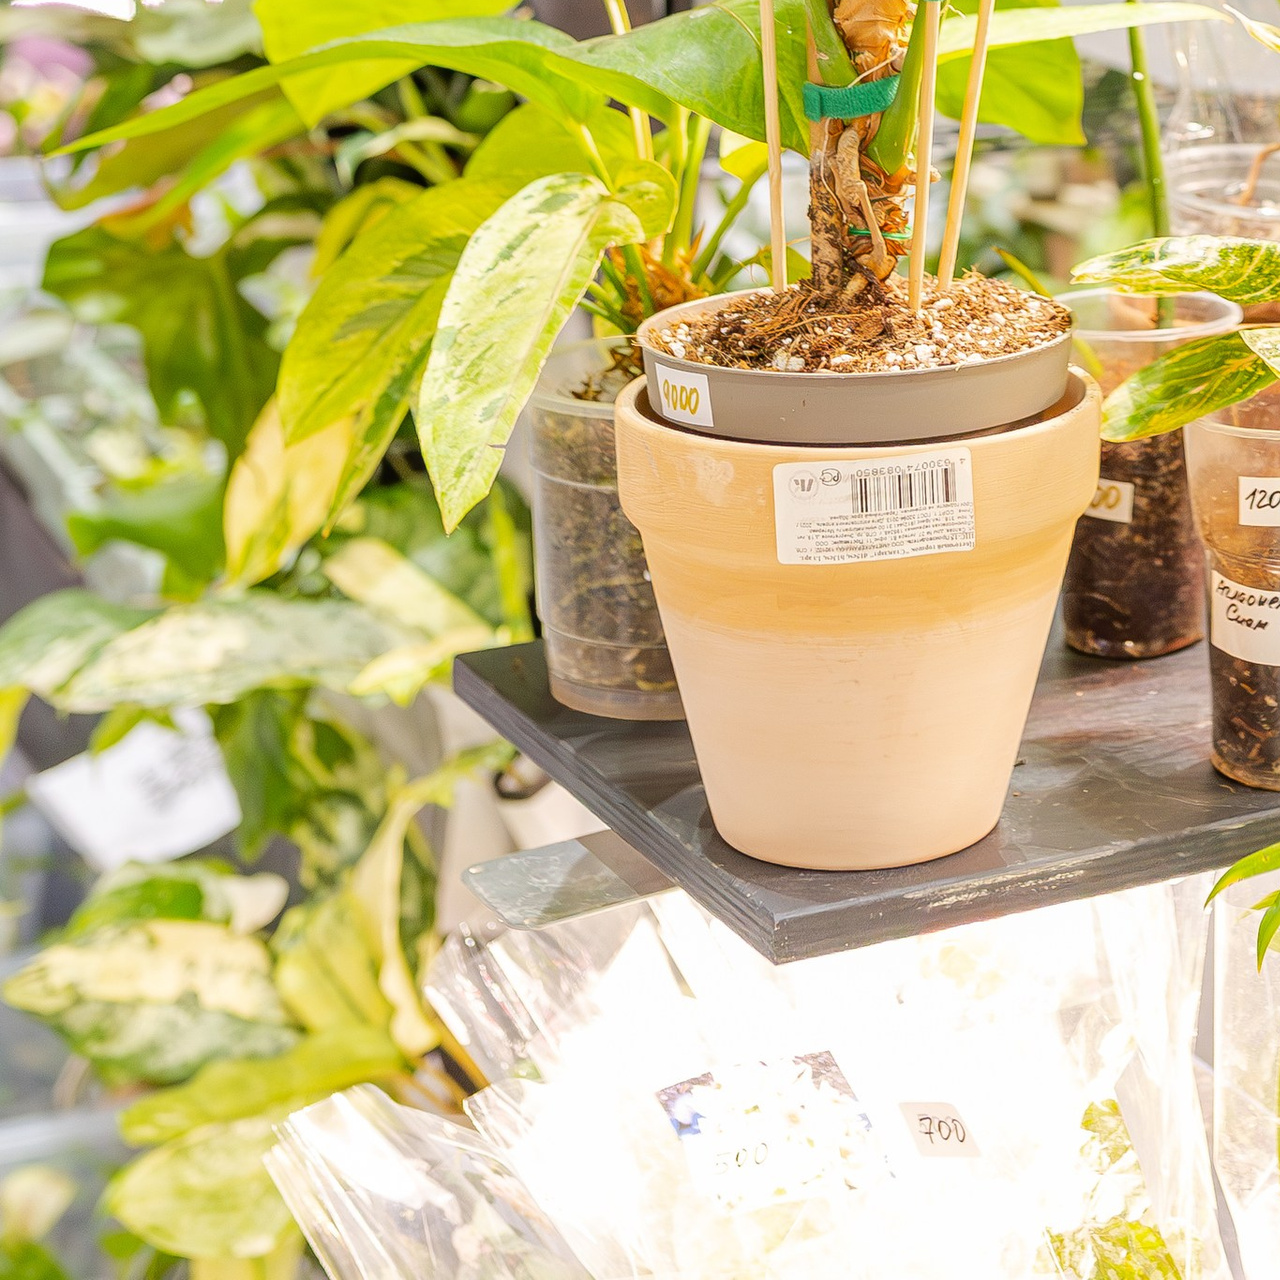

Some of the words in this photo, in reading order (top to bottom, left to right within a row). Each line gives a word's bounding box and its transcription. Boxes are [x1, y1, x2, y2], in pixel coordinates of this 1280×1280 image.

[662, 378, 700, 416] 9000
[855, 466, 901, 478] 083850
[906, 459, 951, 471] 630074
[918, 1116, 966, 1145] 700
